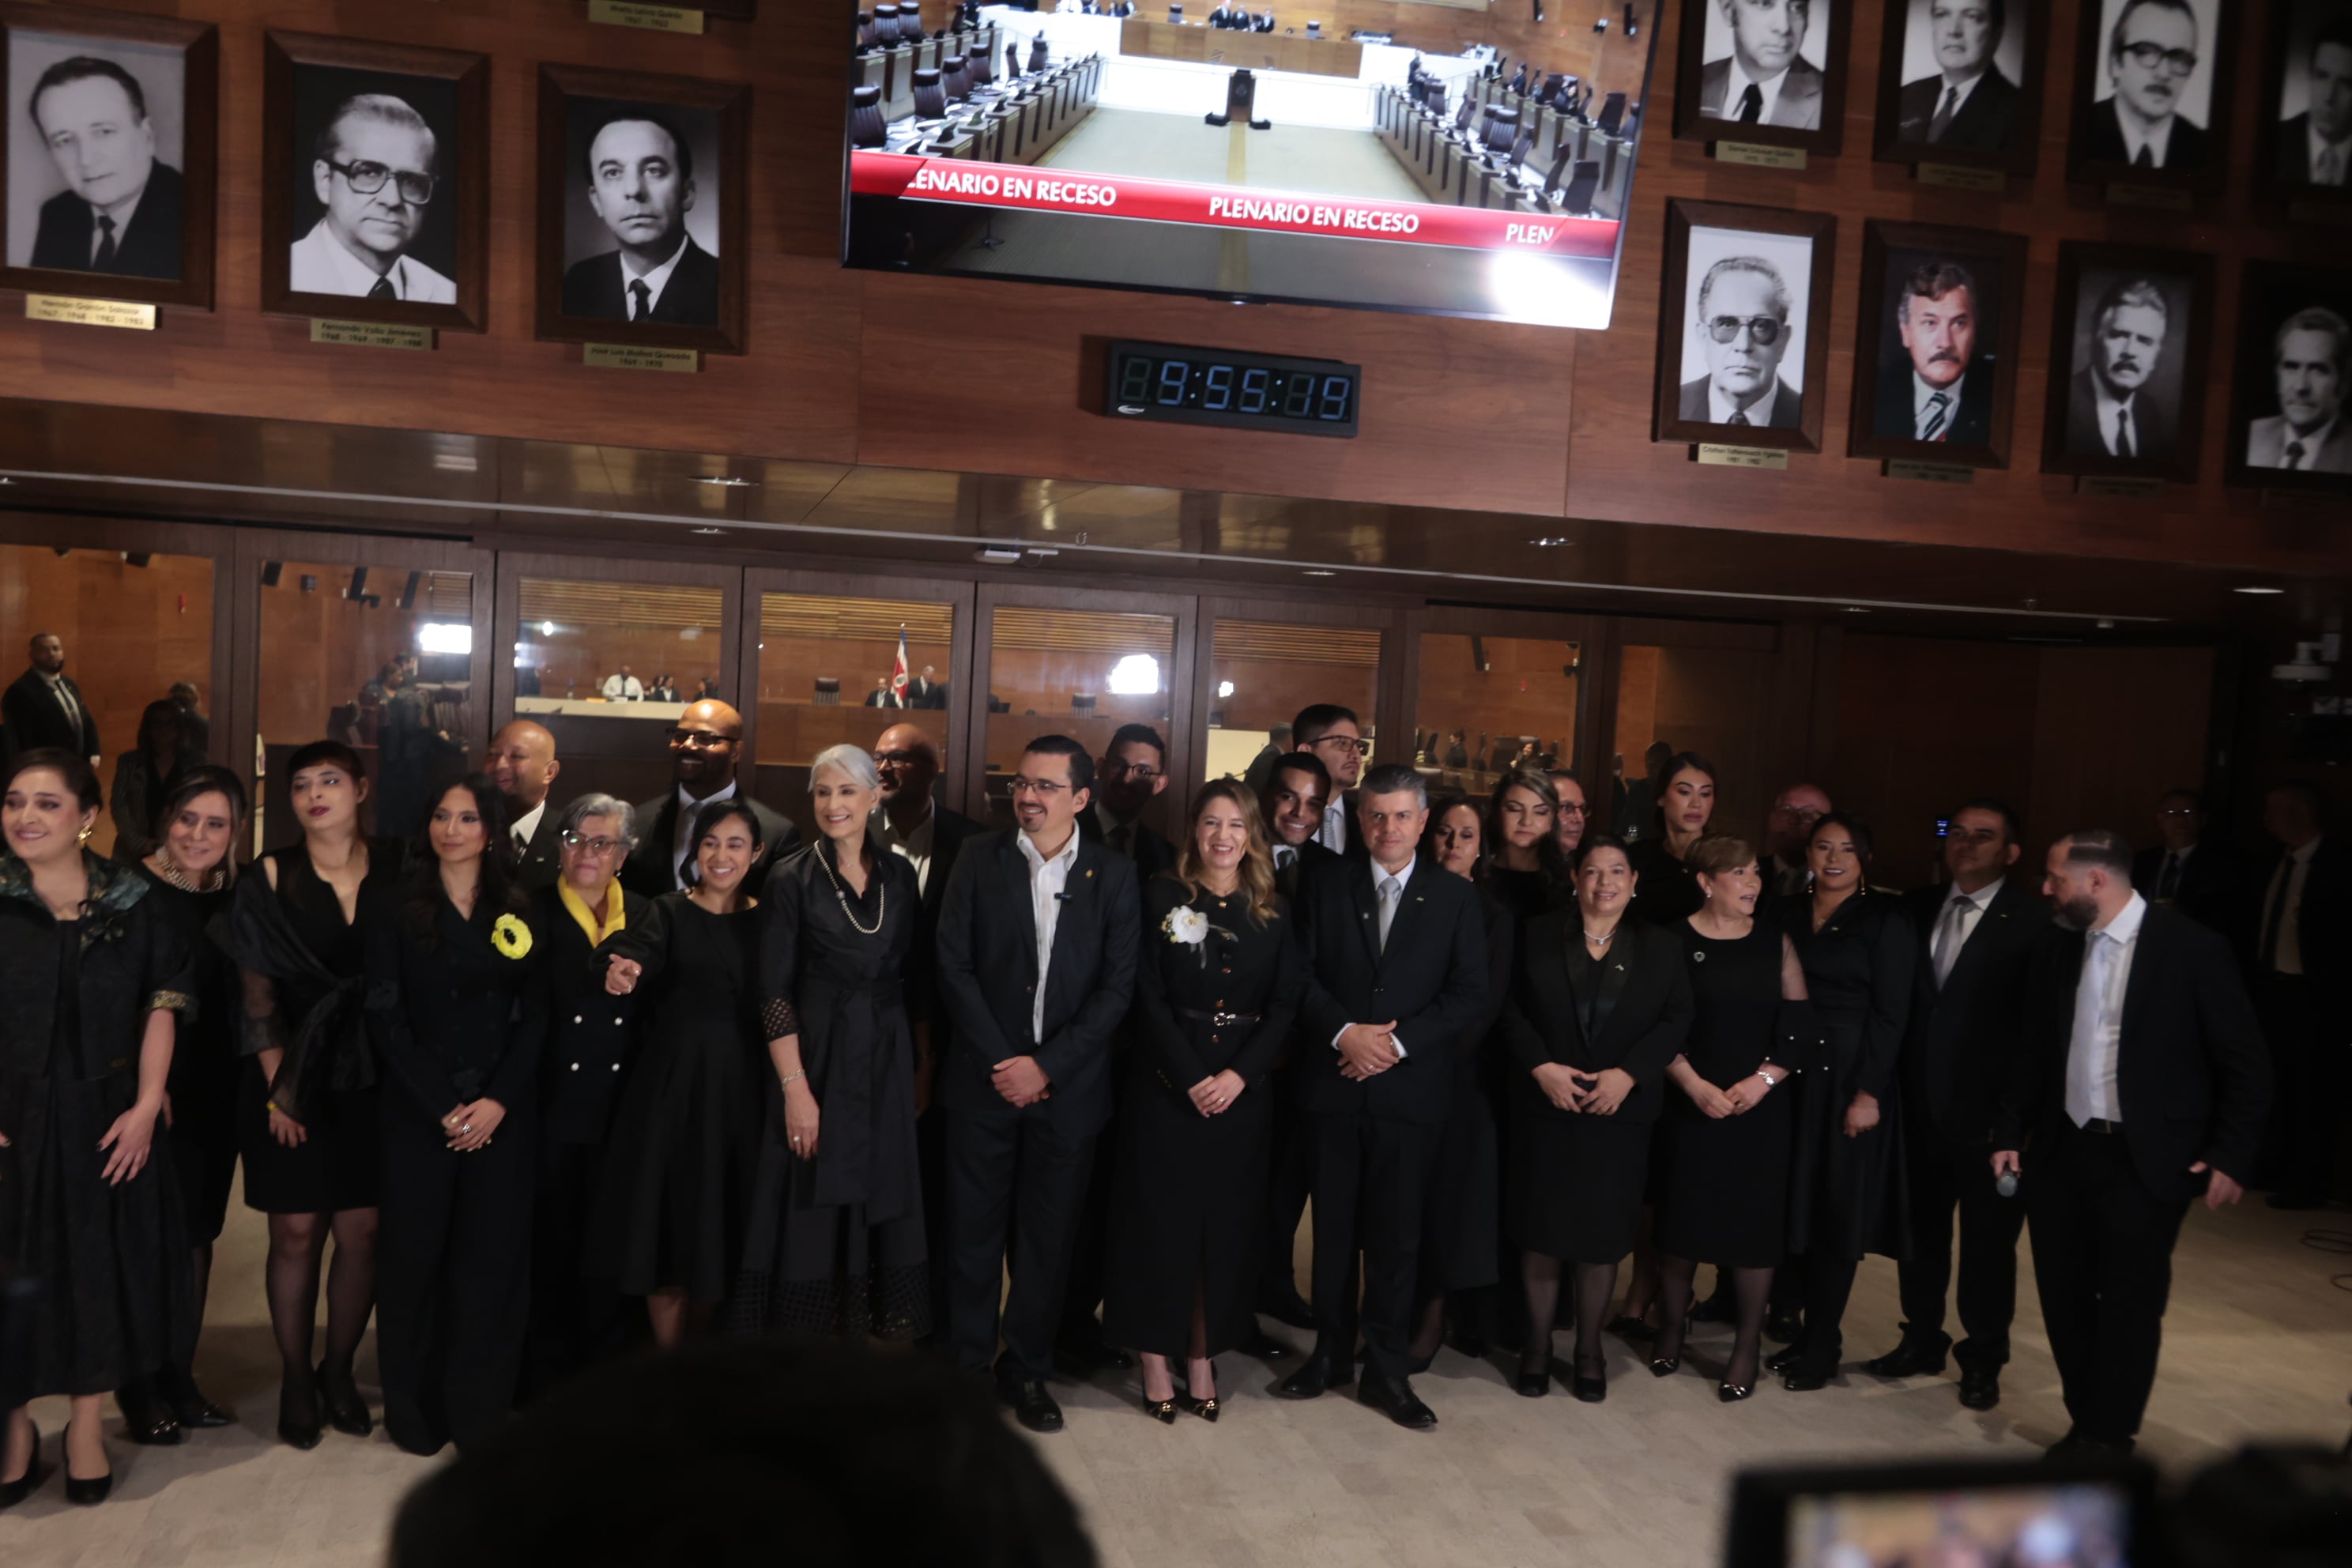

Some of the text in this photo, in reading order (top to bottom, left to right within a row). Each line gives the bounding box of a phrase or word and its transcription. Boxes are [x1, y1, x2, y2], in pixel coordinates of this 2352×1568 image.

[906, 168, 1555, 244] ENARIO EN RECESO PLENARIO EN RECESO PLEN
